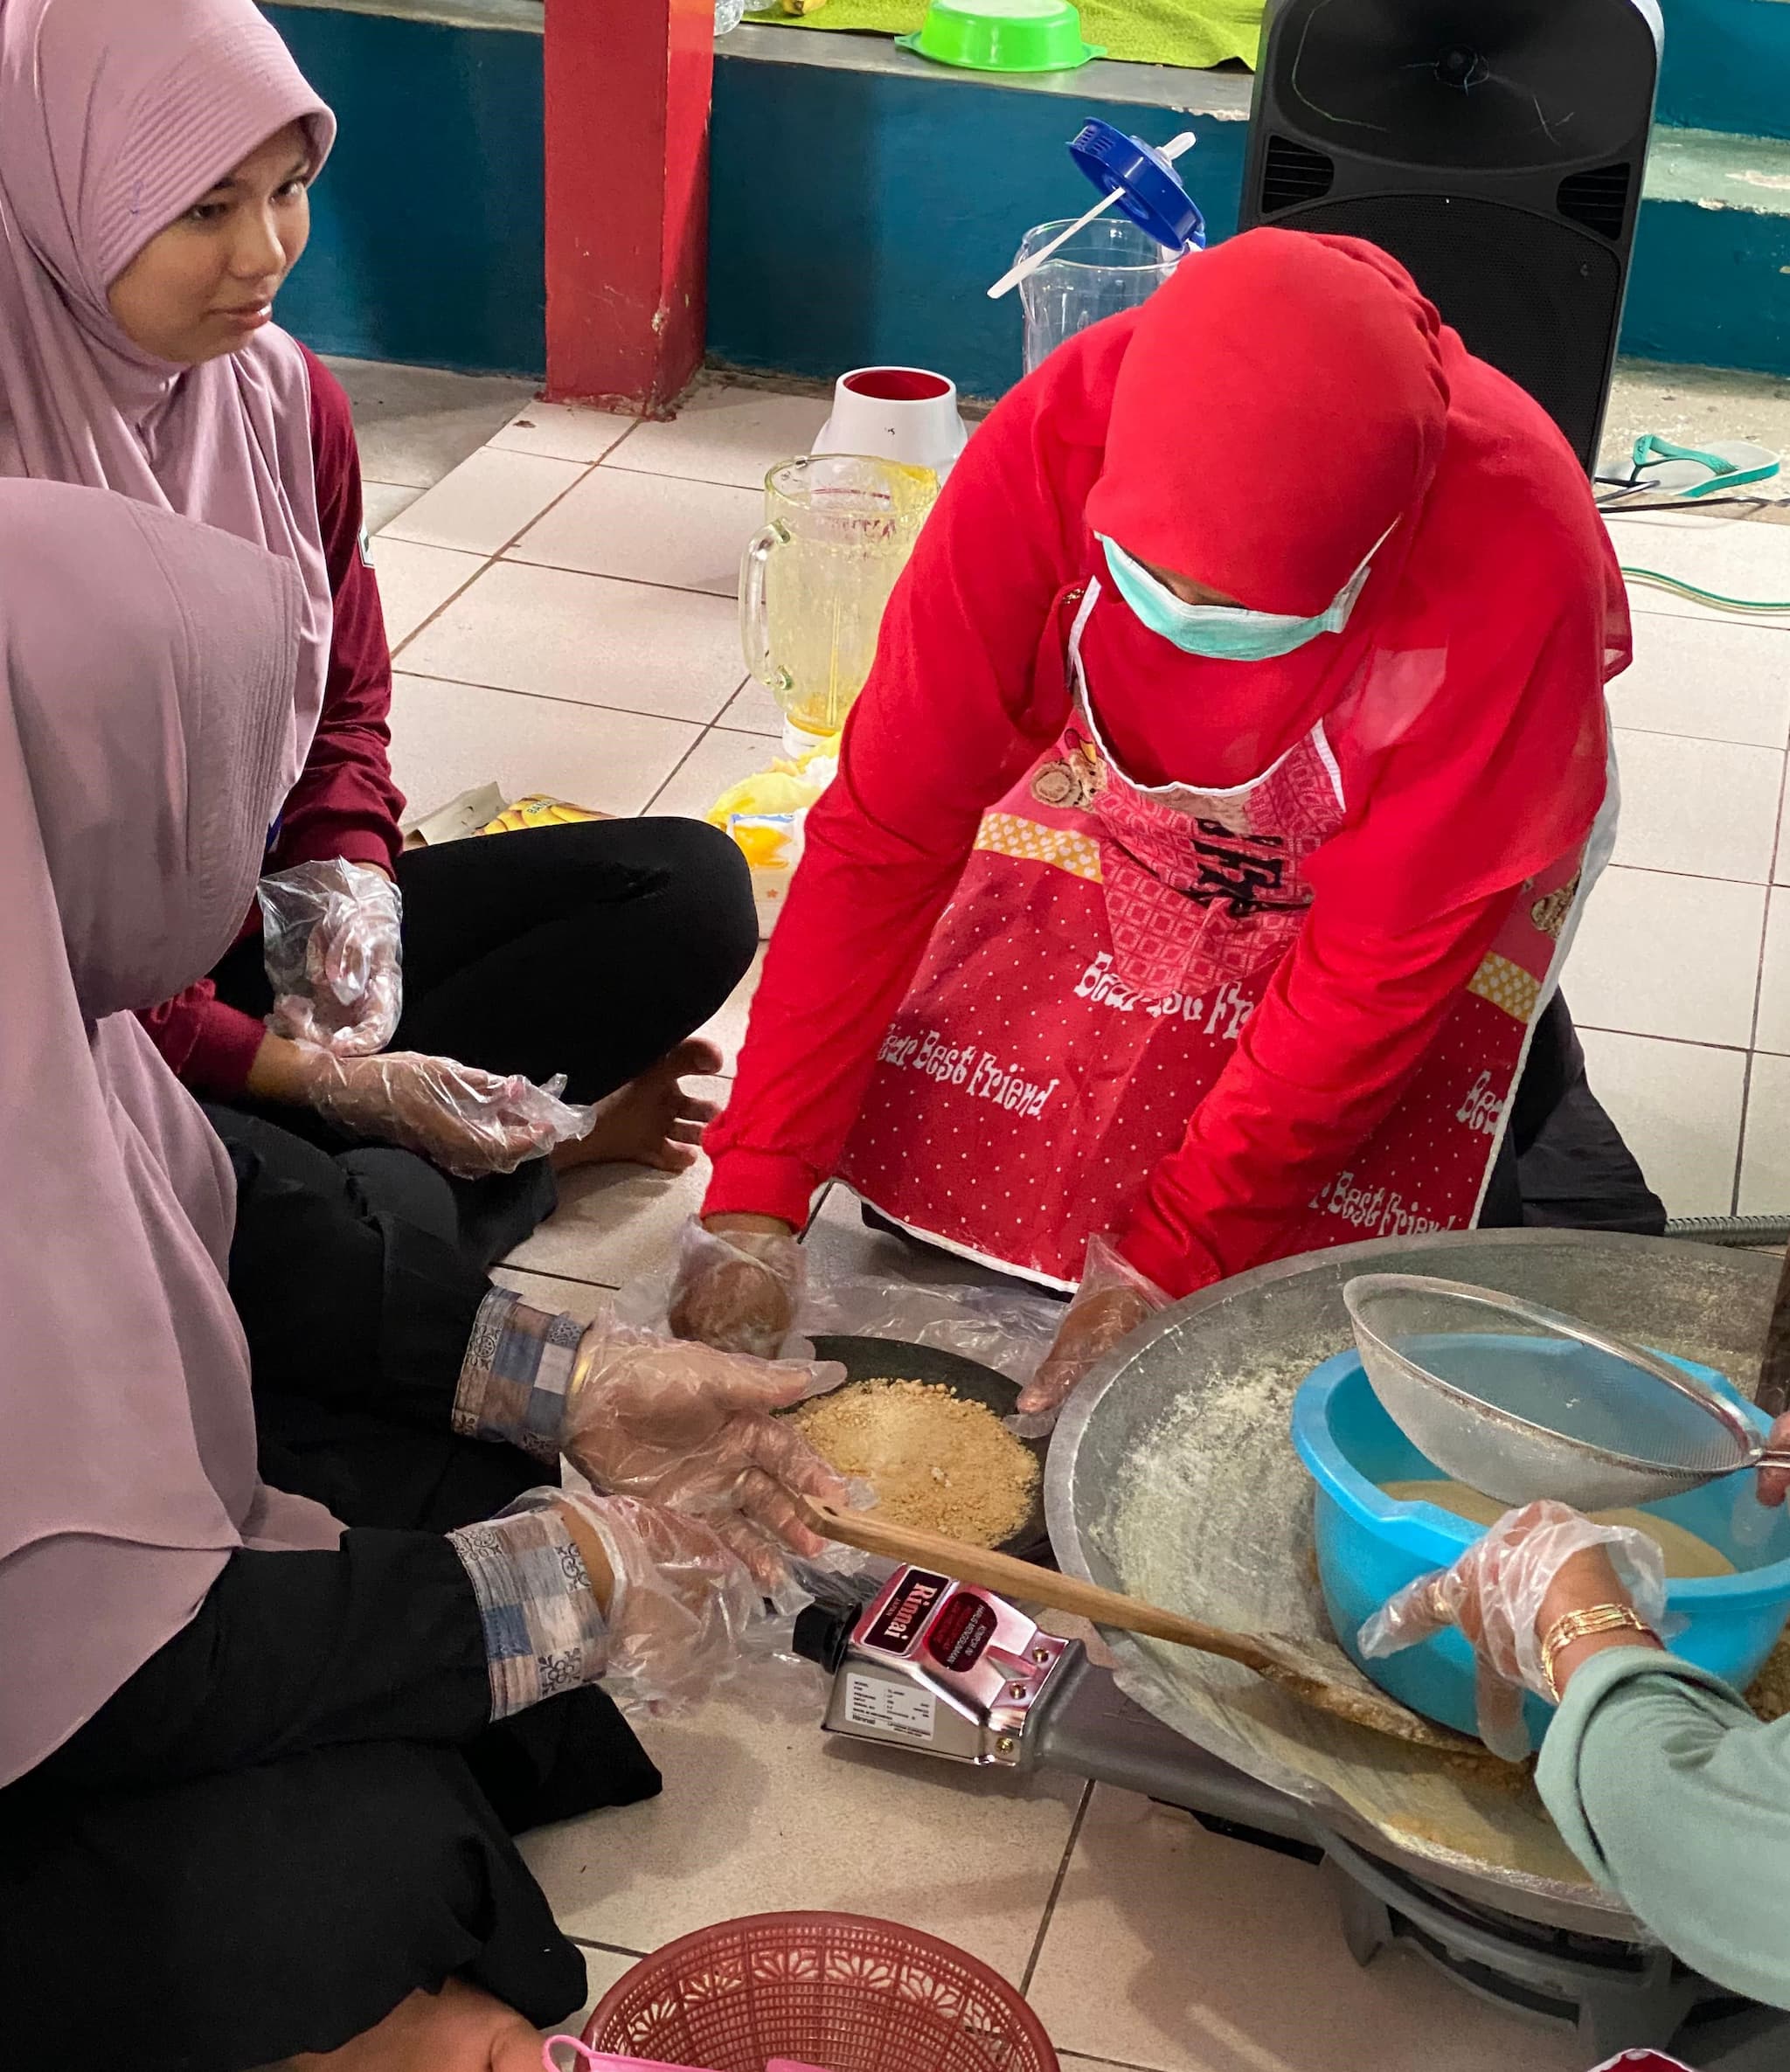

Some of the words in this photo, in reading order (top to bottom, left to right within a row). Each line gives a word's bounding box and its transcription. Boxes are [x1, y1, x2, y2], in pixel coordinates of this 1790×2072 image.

[878, 1023, 918, 1066] ear
[912, 1030, 976, 1085] Best
[966, 1051, 1060, 1118] Friend
[1456, 1071, 1505, 1136] Bea
[1327, 1171, 1386, 1228] Best
[884, 1583, 939, 1640] Rinnai
[970, 1604, 986, 1625] HARUS
[947, 1622, 976, 1664] MENGGUNAKAN
